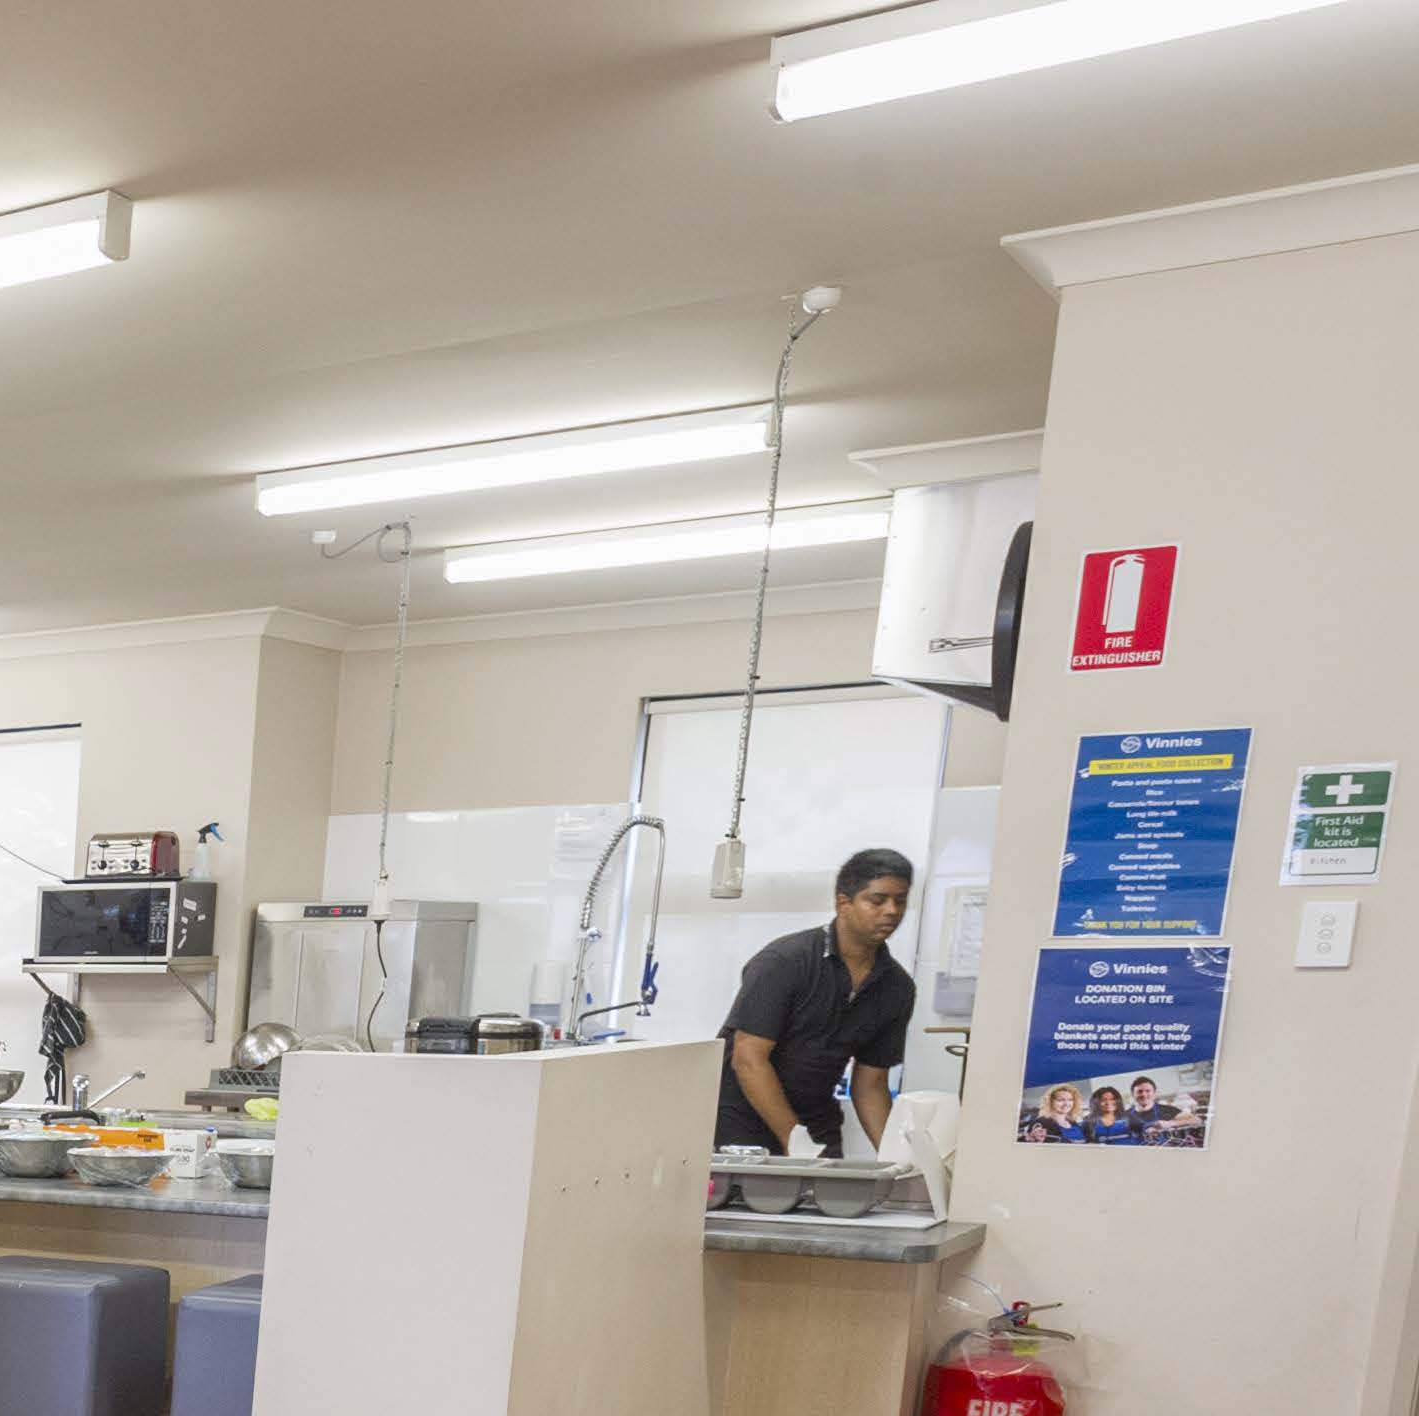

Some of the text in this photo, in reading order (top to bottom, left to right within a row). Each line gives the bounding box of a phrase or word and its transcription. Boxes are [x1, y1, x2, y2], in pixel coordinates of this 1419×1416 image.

[1104, 636, 1132, 649] FIRE
[1071, 650, 1162, 666] EXTINGUISHER
[1145, 736, 1203, 749] Vinnies
[1314, 815, 1365, 827] First Aid
[1323, 827, 1352, 837] kit is
[1314, 837, 1360, 848] located
[1113, 963, 1169, 975] Vinnies
[1085, 984, 1167, 994] DONATION BIN
[1074, 995, 1174, 1004] LOCATED ON SITE
[1057, 1022, 1190, 1033] Donate your good quality
[1053, 1032, 1192, 1042] blankets and coats to help
[1056, 1042, 1186, 1051] those in need this winter
